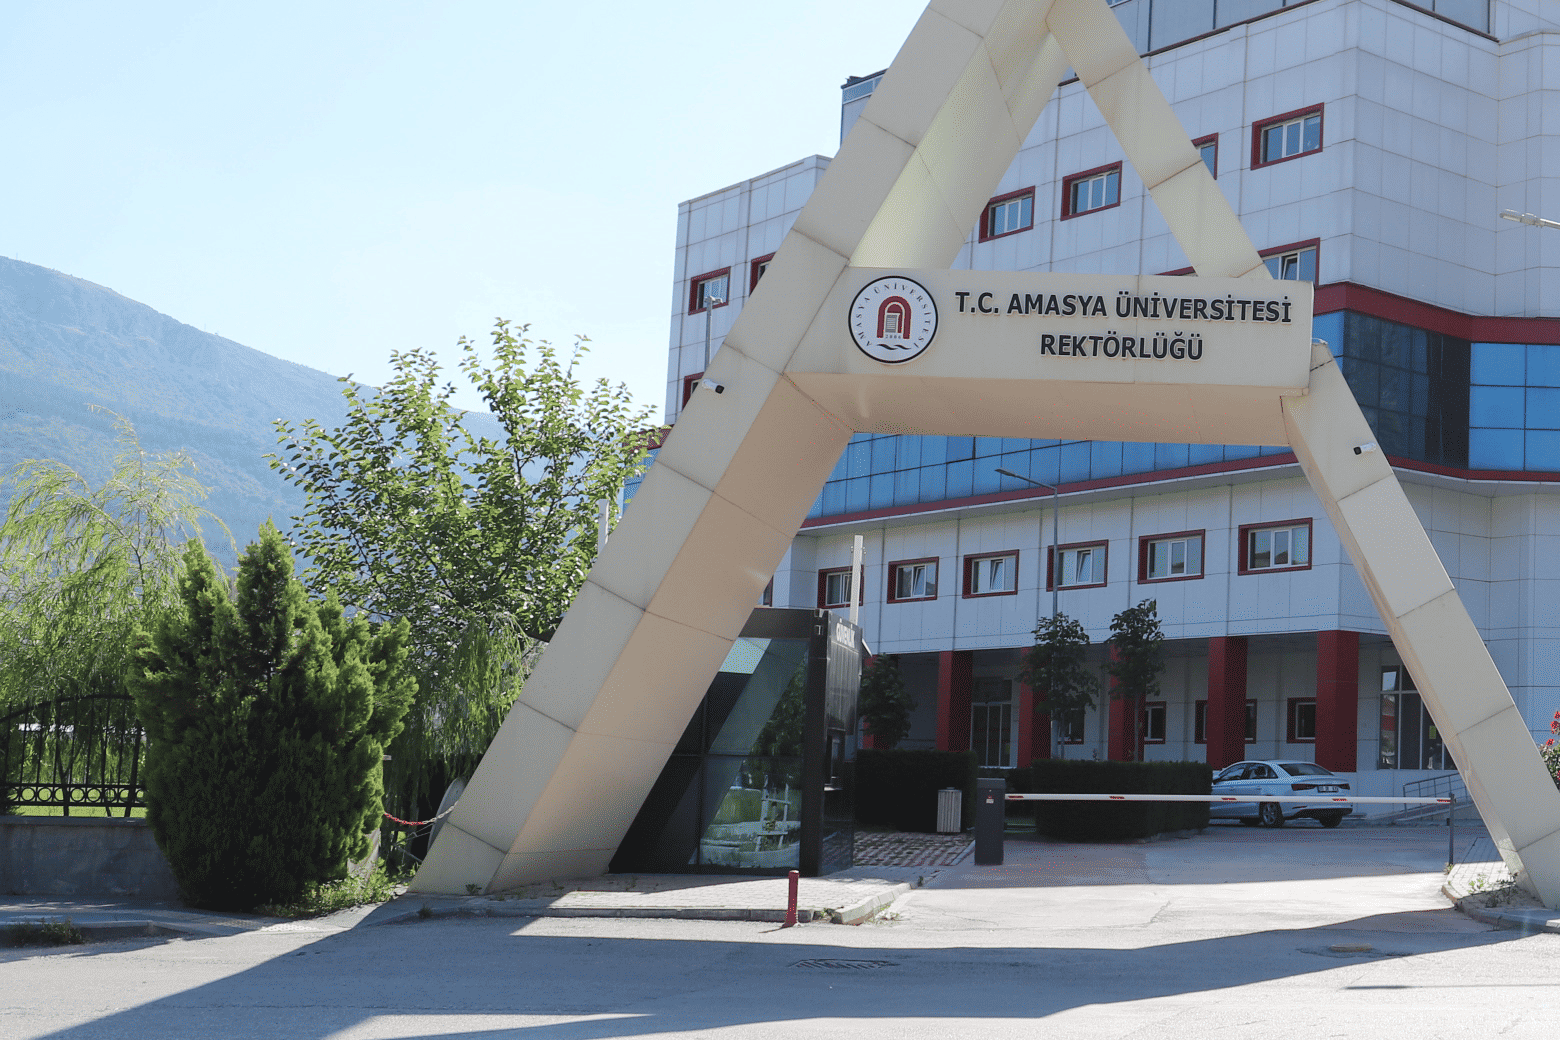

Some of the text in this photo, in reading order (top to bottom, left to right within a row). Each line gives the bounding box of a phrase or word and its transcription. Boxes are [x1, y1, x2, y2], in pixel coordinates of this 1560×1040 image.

[955, 290, 1292, 323] T.C. AMASYA ÜNİVERSİTESİ
[1040, 330, 1203, 361] REKTÖRLÜĞÜ
